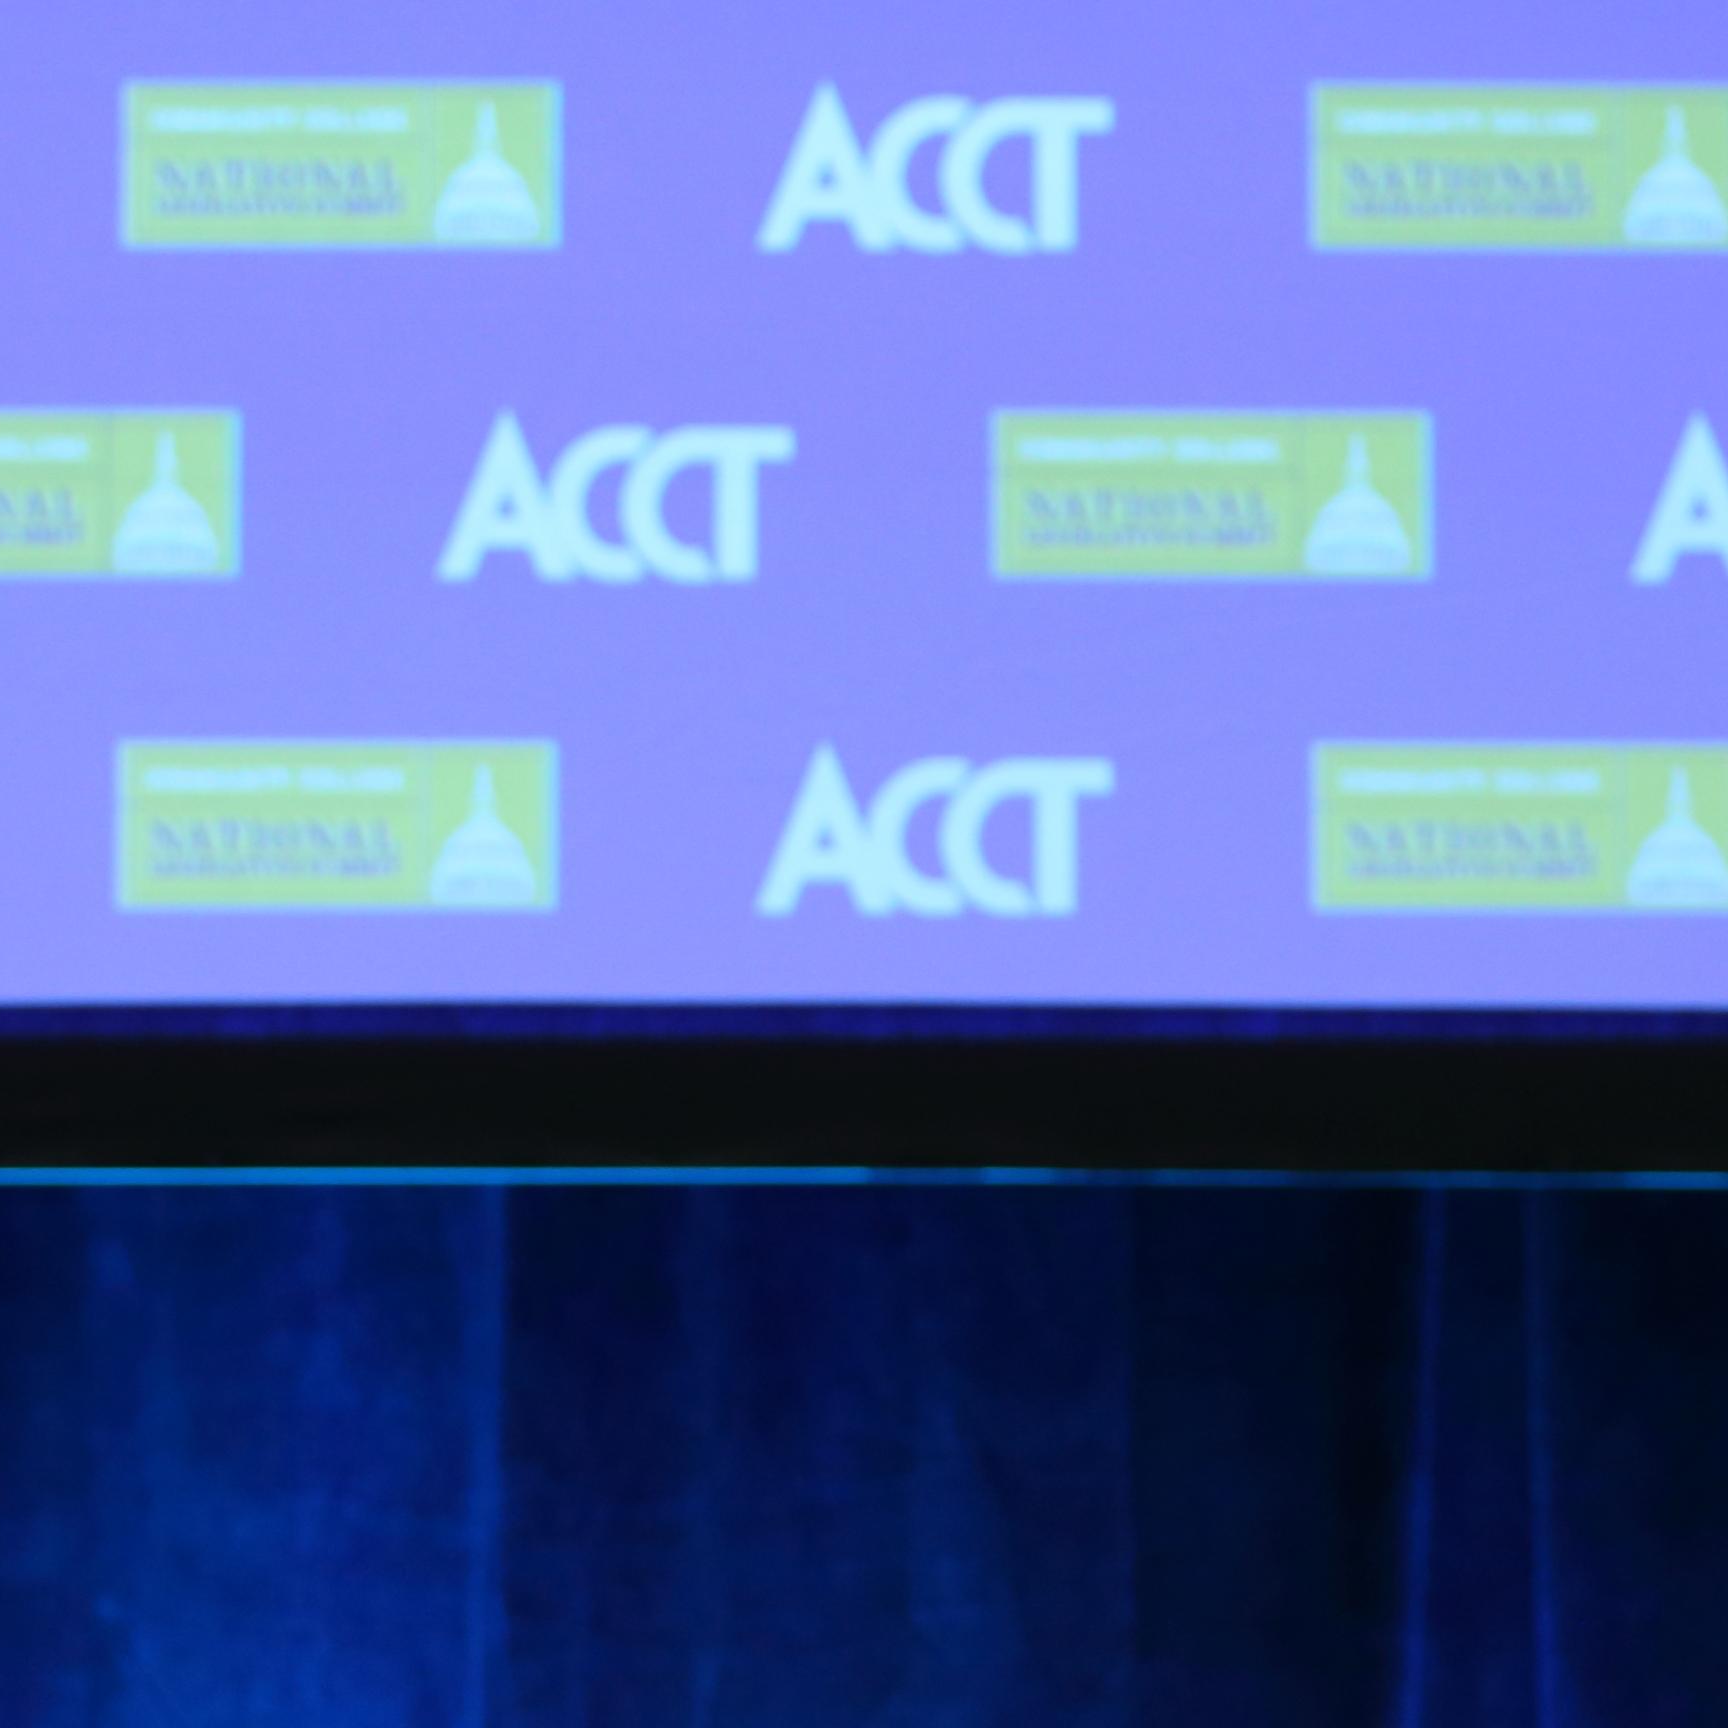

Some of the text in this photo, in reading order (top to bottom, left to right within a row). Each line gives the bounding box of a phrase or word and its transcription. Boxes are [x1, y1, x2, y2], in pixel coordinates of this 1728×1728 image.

[757, 80, 1114, 253] ACCT
[436, 409, 795, 583] ACCT
[756, 739, 1114, 916] ACCT
